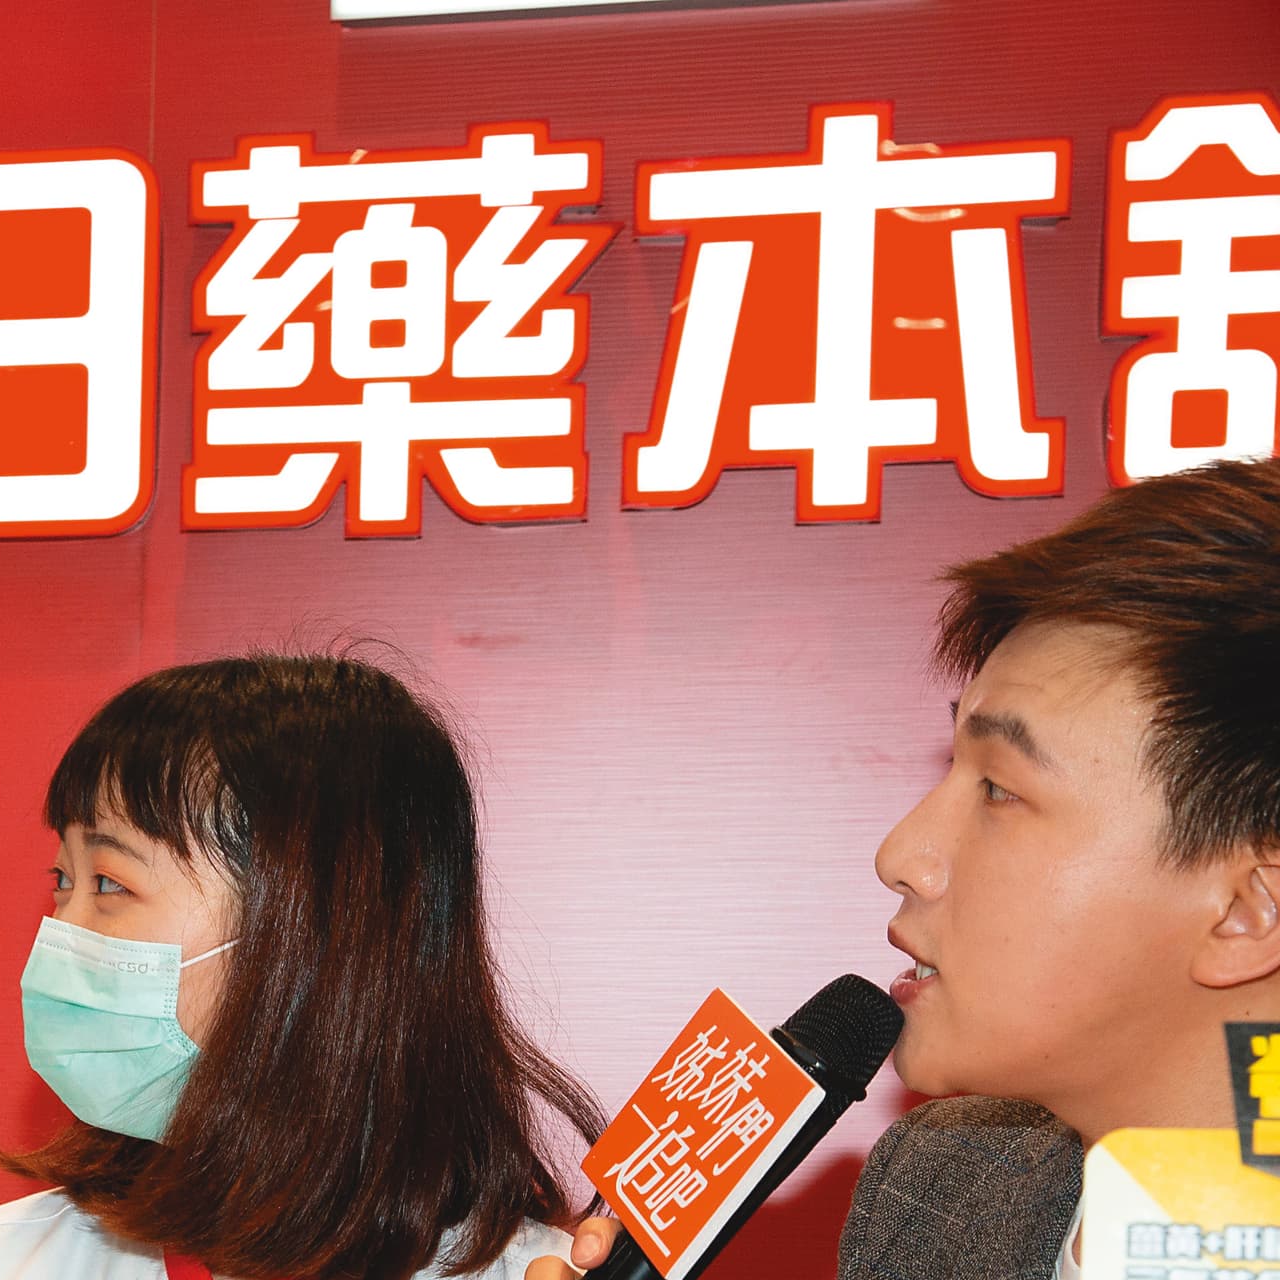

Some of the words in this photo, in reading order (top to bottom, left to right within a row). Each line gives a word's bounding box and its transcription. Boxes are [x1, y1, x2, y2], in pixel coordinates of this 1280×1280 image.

[650, 1024, 776, 1177] 姊妹們
[603, 1103, 708, 1258] 追吧
